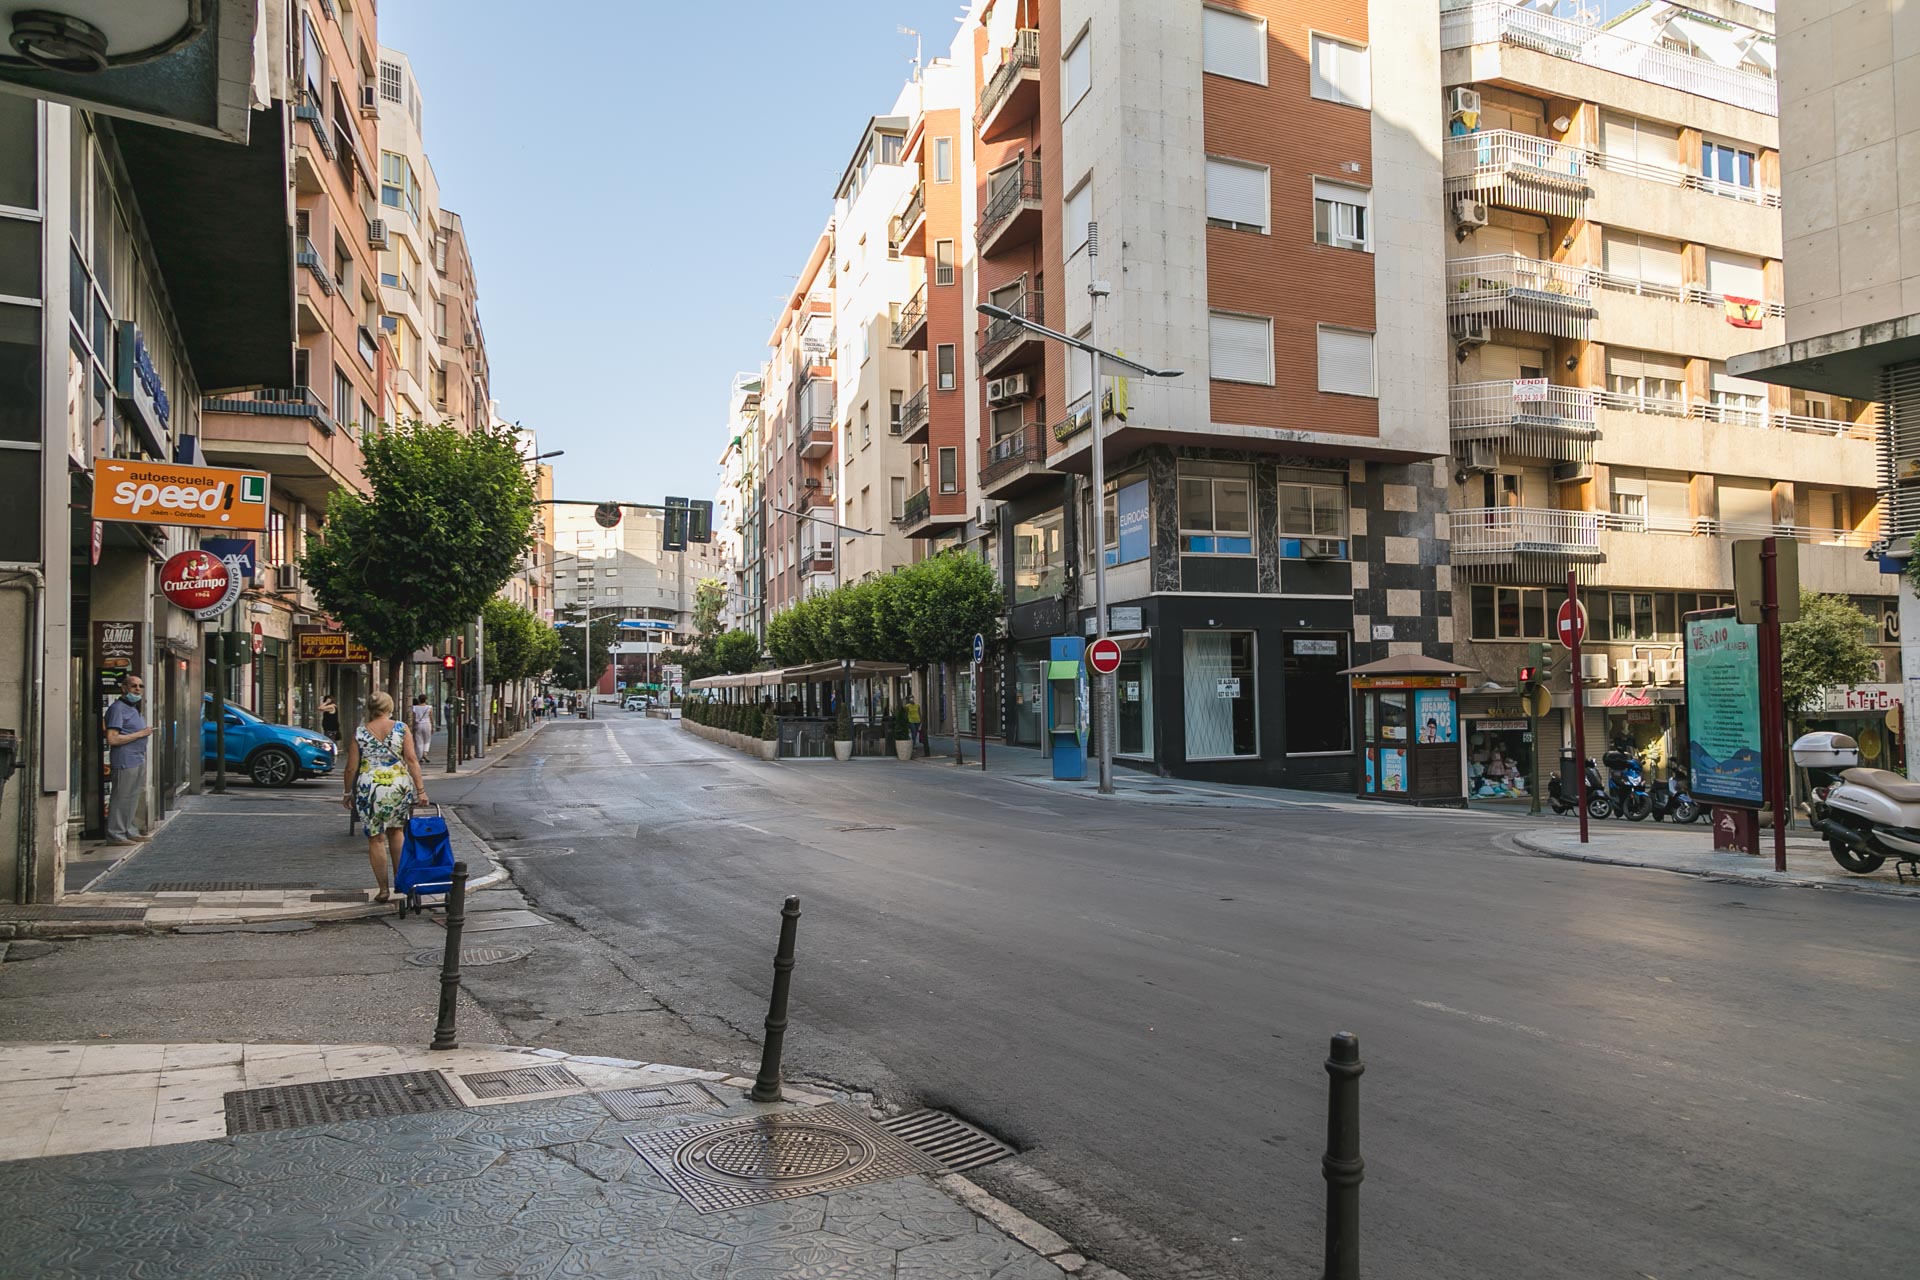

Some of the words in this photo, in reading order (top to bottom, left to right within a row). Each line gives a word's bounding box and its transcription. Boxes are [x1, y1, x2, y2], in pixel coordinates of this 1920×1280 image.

[130, 472, 214, 486] autoescuela
[244, 478, 263, 501] L
[222, 553, 252, 569] AXA
[163, 577, 226, 592] Cruzcampo
[200, 602, 228, 618] SAMOA
[102, 628, 134, 643] SAMOA
[302, 636, 345, 646] PERFUMERIA
[1693, 627, 1728, 651] VERANO
[1421, 702, 1451, 712] JUGAMOS
